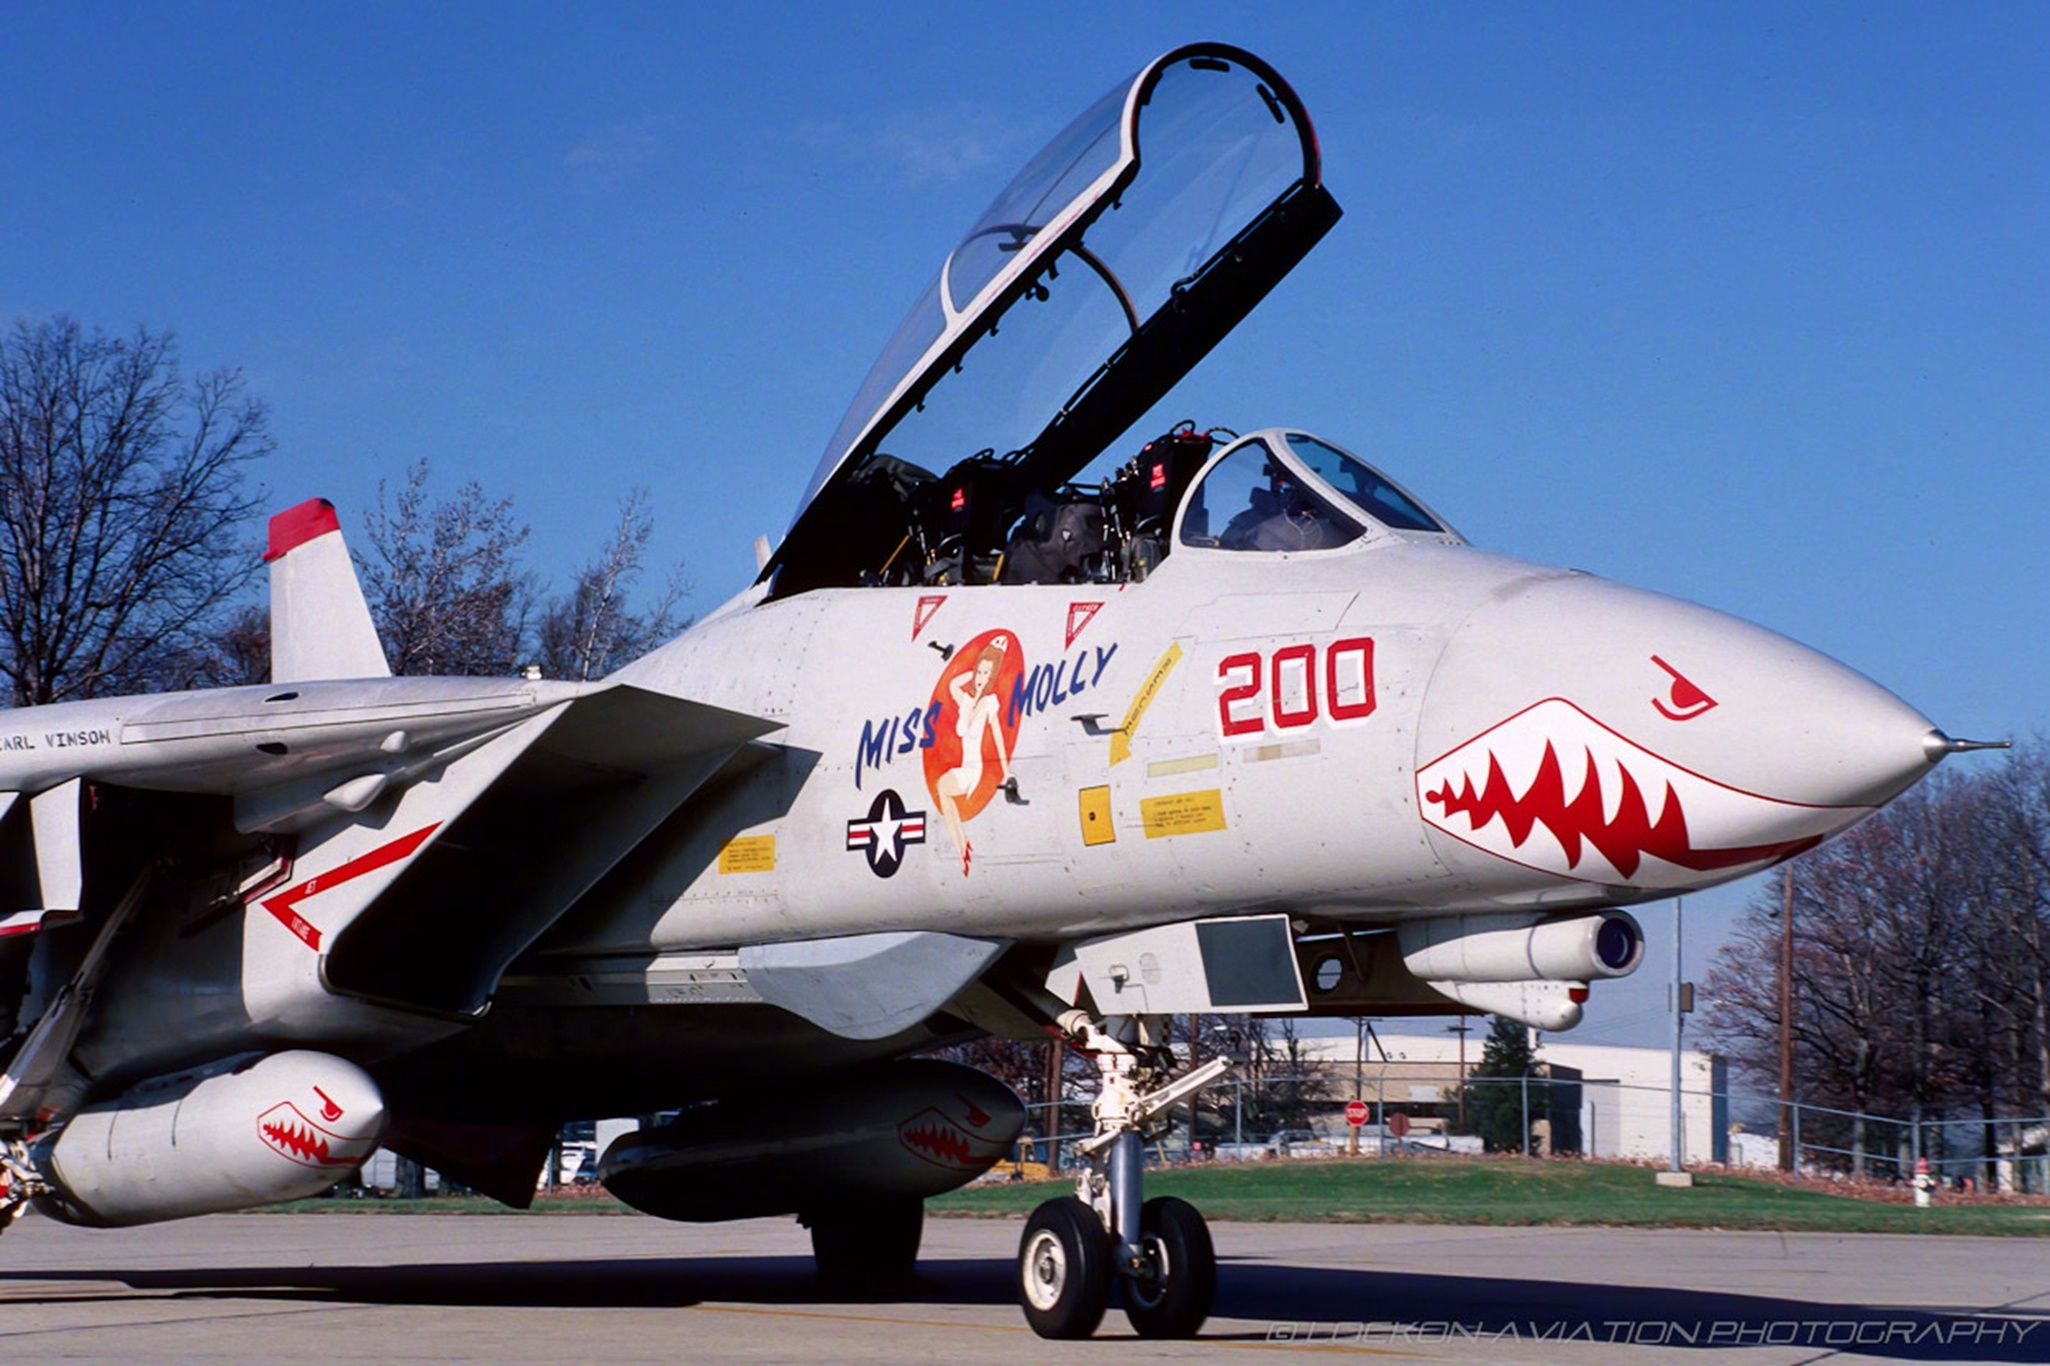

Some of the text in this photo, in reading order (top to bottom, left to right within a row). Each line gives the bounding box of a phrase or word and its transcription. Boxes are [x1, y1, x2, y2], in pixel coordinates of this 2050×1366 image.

[855, 643, 1118, 790] MISS MOLLY
[1217, 636, 1378, 740] 200
[0, 729, 111, 751] ARL VINSON
[1346, 1107, 1367, 1119] STOP
